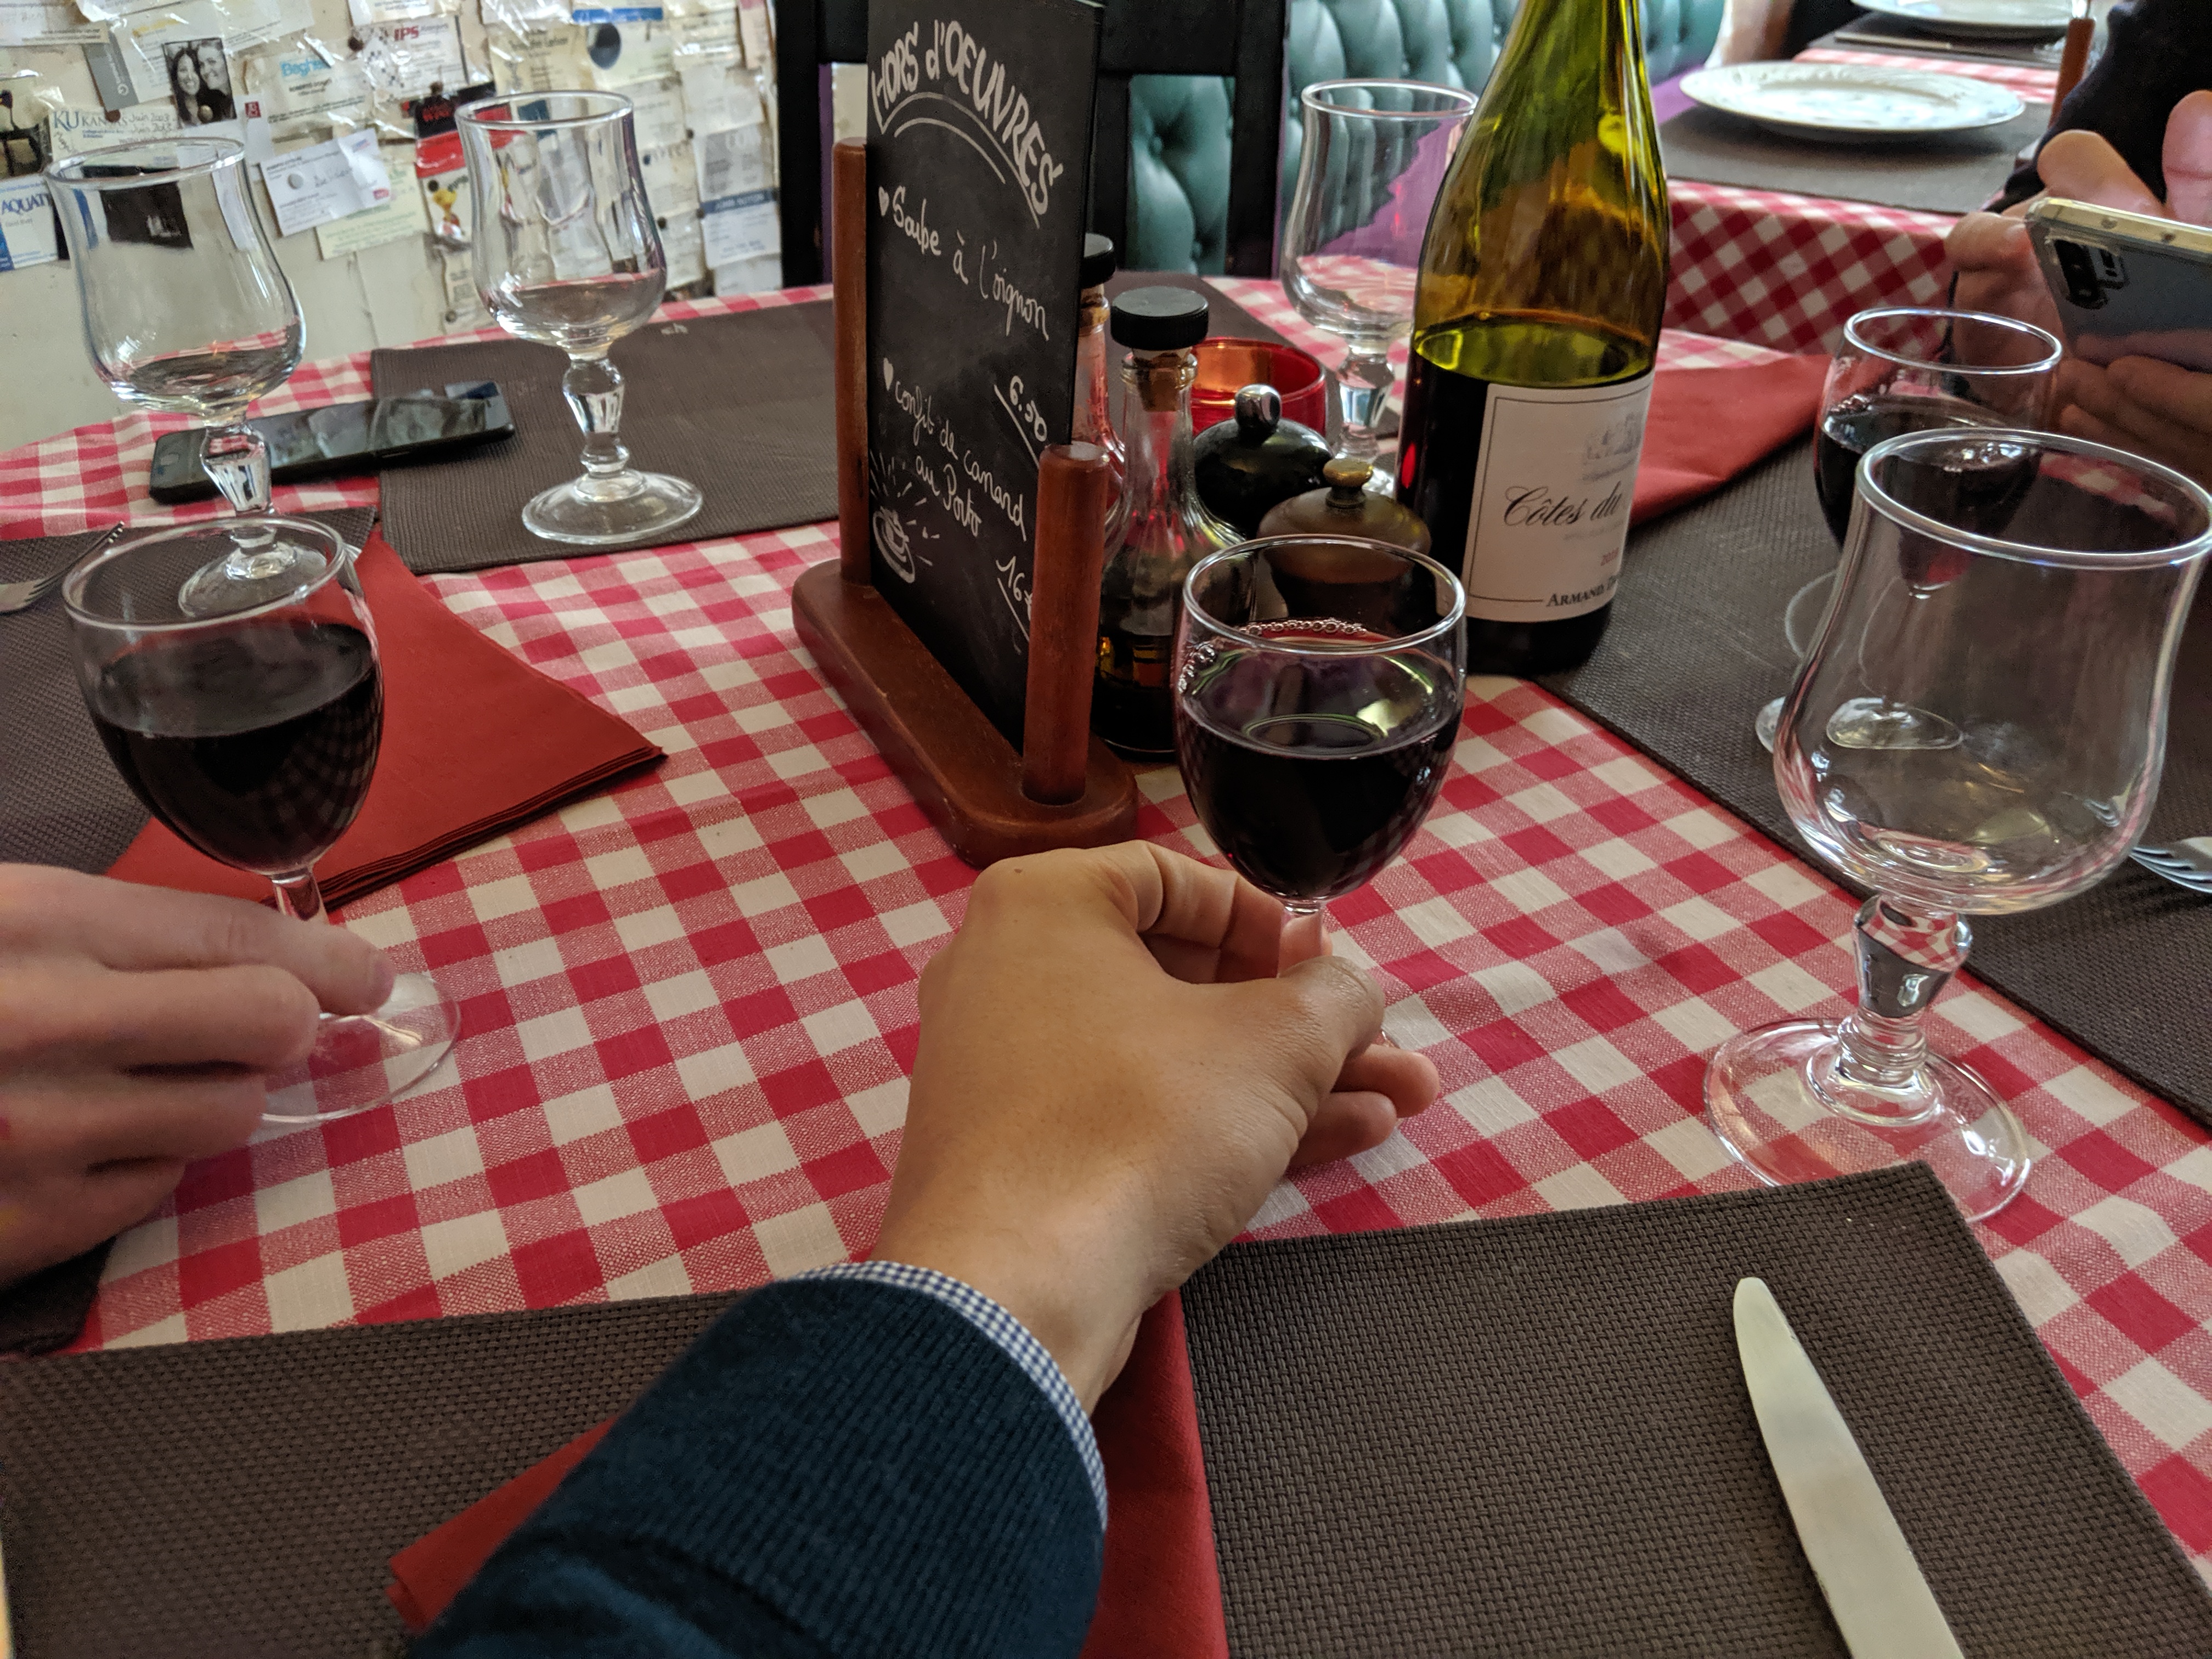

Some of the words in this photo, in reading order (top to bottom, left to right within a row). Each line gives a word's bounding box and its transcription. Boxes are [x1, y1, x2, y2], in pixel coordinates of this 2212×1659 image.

[393, 26, 419, 41] IPS
[54, 111, 80, 131] KU
[82, 116, 128, 127] KANAS
[872, 21, 918, 126] HORS
[926, 19, 1064, 215] d'OEUVRES
[892, 185, 941, 256] Soupe
[953, 229, 969, 285] à
[979, 239, 1049, 341] l'oignon
[1009, 375, 1048, 442] 6.50
[940, 419, 958, 460] de
[916, 455, 941, 496] au
[943, 463, 982, 537] Porto
[1503, 486, 1588, 526] Côtes
[1590, 481, 1622, 521] du
[1546, 584, 1605, 607] ARMAND
